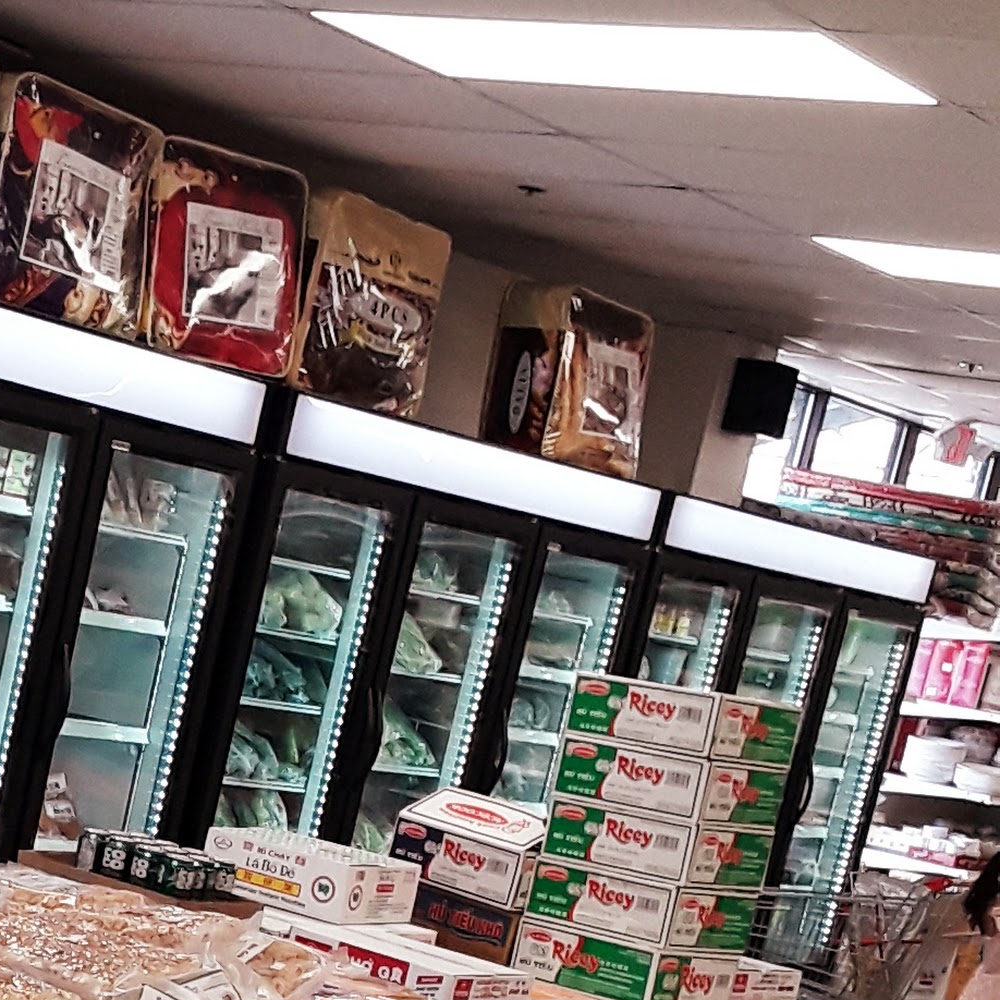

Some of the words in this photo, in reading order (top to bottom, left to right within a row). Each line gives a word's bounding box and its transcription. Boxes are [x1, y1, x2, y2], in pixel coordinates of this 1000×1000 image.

[630, 690, 677, 721] Ricey
[617, 755, 665, 786] Ricey
[606, 818, 653, 848] Ricey
[443, 838, 487, 872] Ricey
[588, 879, 635, 910] Ricey
[552, 940, 599, 973] Ricey
